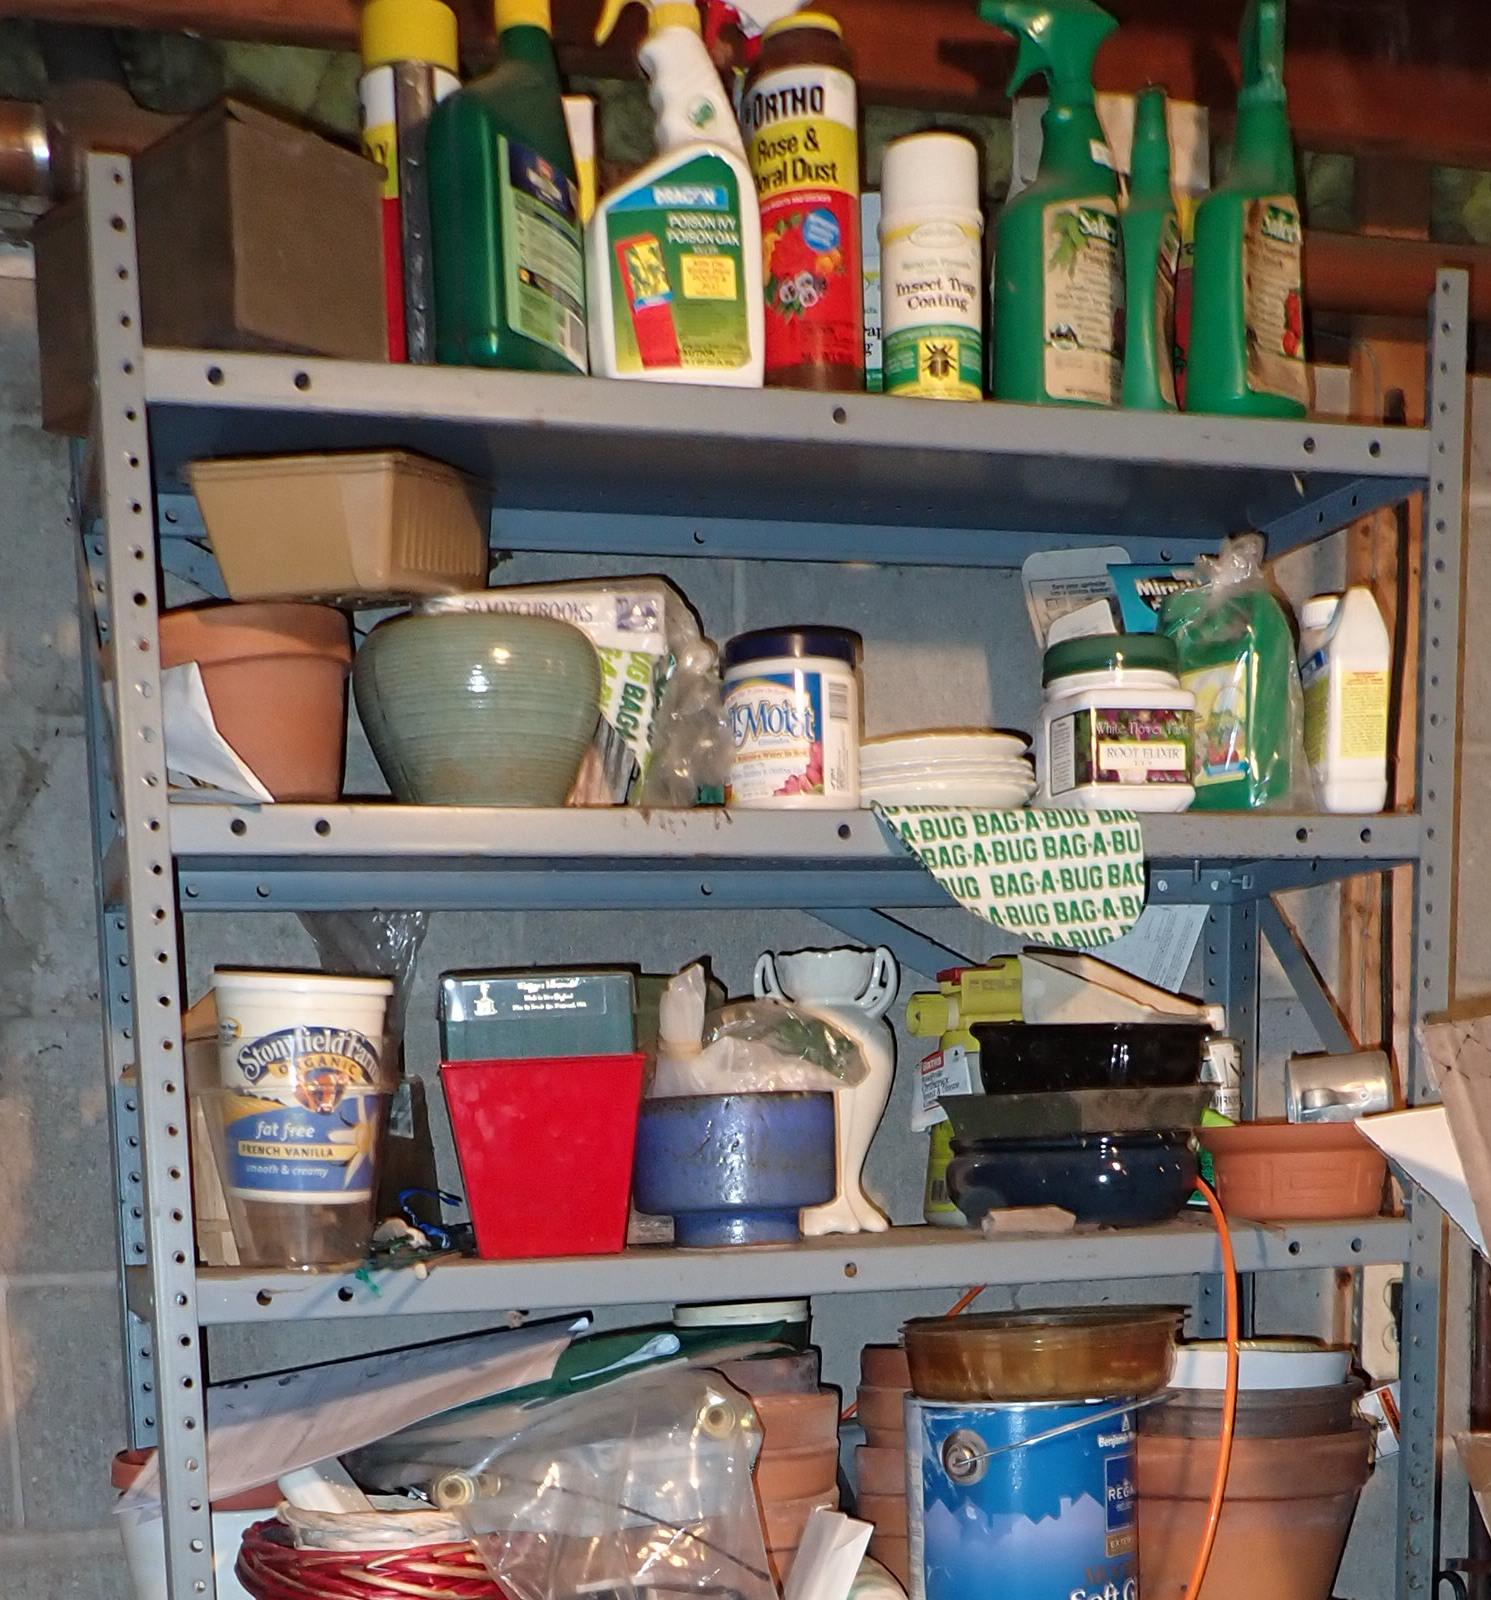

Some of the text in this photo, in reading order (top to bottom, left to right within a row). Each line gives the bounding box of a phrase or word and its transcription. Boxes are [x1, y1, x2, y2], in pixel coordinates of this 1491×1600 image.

[792, 158, 838, 183] Dust
[896, 277, 977, 298] Insect Trap
[907, 293, 969, 313] Coating
[237, 1025, 346, 1082] Stonyfield
[255, 1120, 316, 1142] fat free
[240, 1143, 334, 1158] FRENCH VANILLA
[280, 1164, 290, 1176] &
[291, 1167, 329, 1179] creamy
